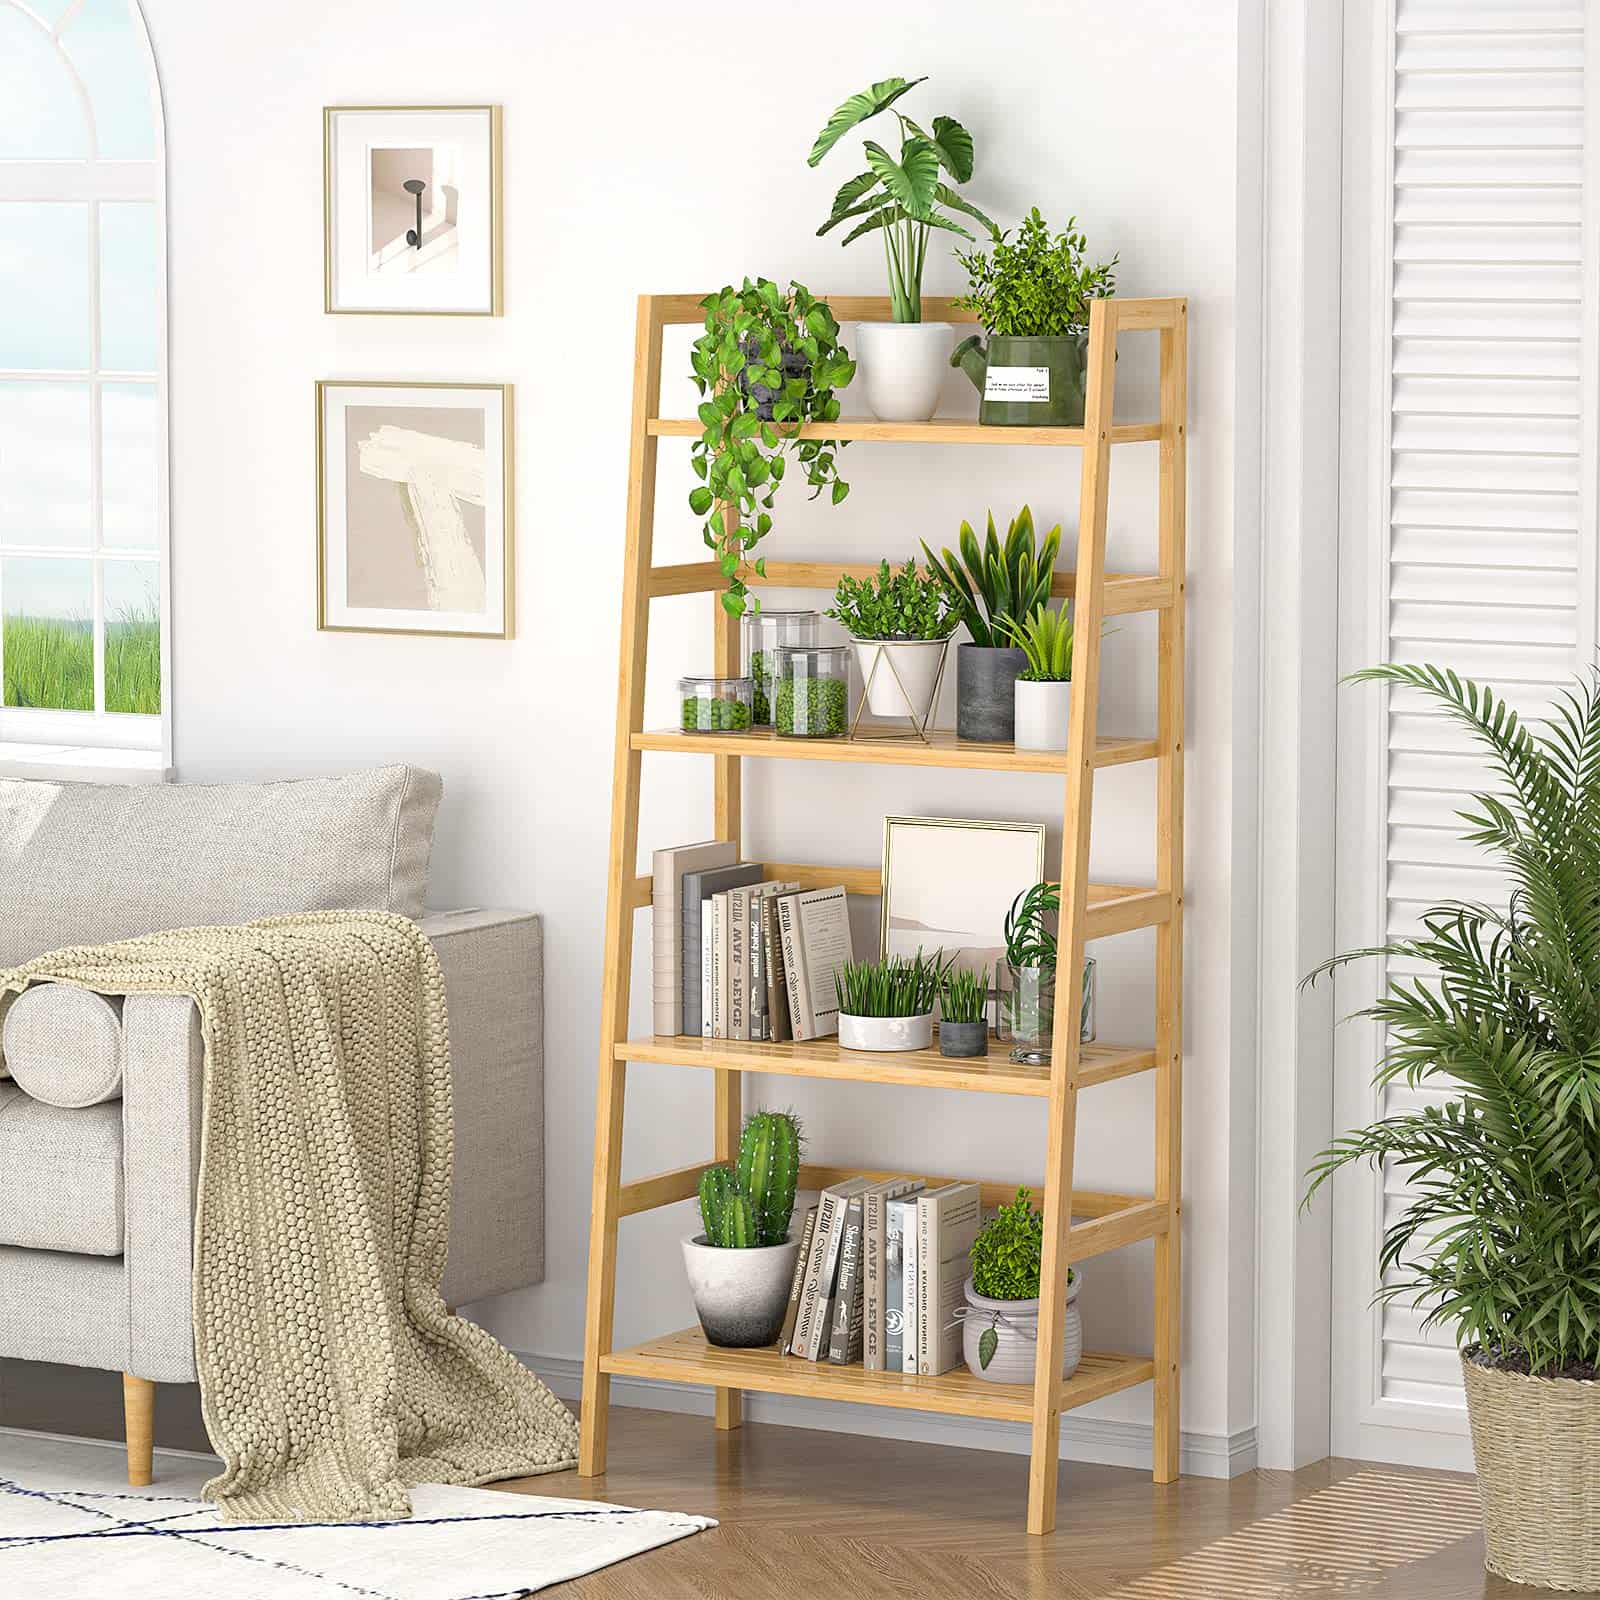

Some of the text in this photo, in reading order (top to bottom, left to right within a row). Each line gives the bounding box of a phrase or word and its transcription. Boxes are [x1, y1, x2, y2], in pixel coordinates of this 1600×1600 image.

[843, 1223, 860, 1260] Sherlock
[791, 1260, 807, 1301] Revolution
[839, 1260, 855, 1291] Holmes
